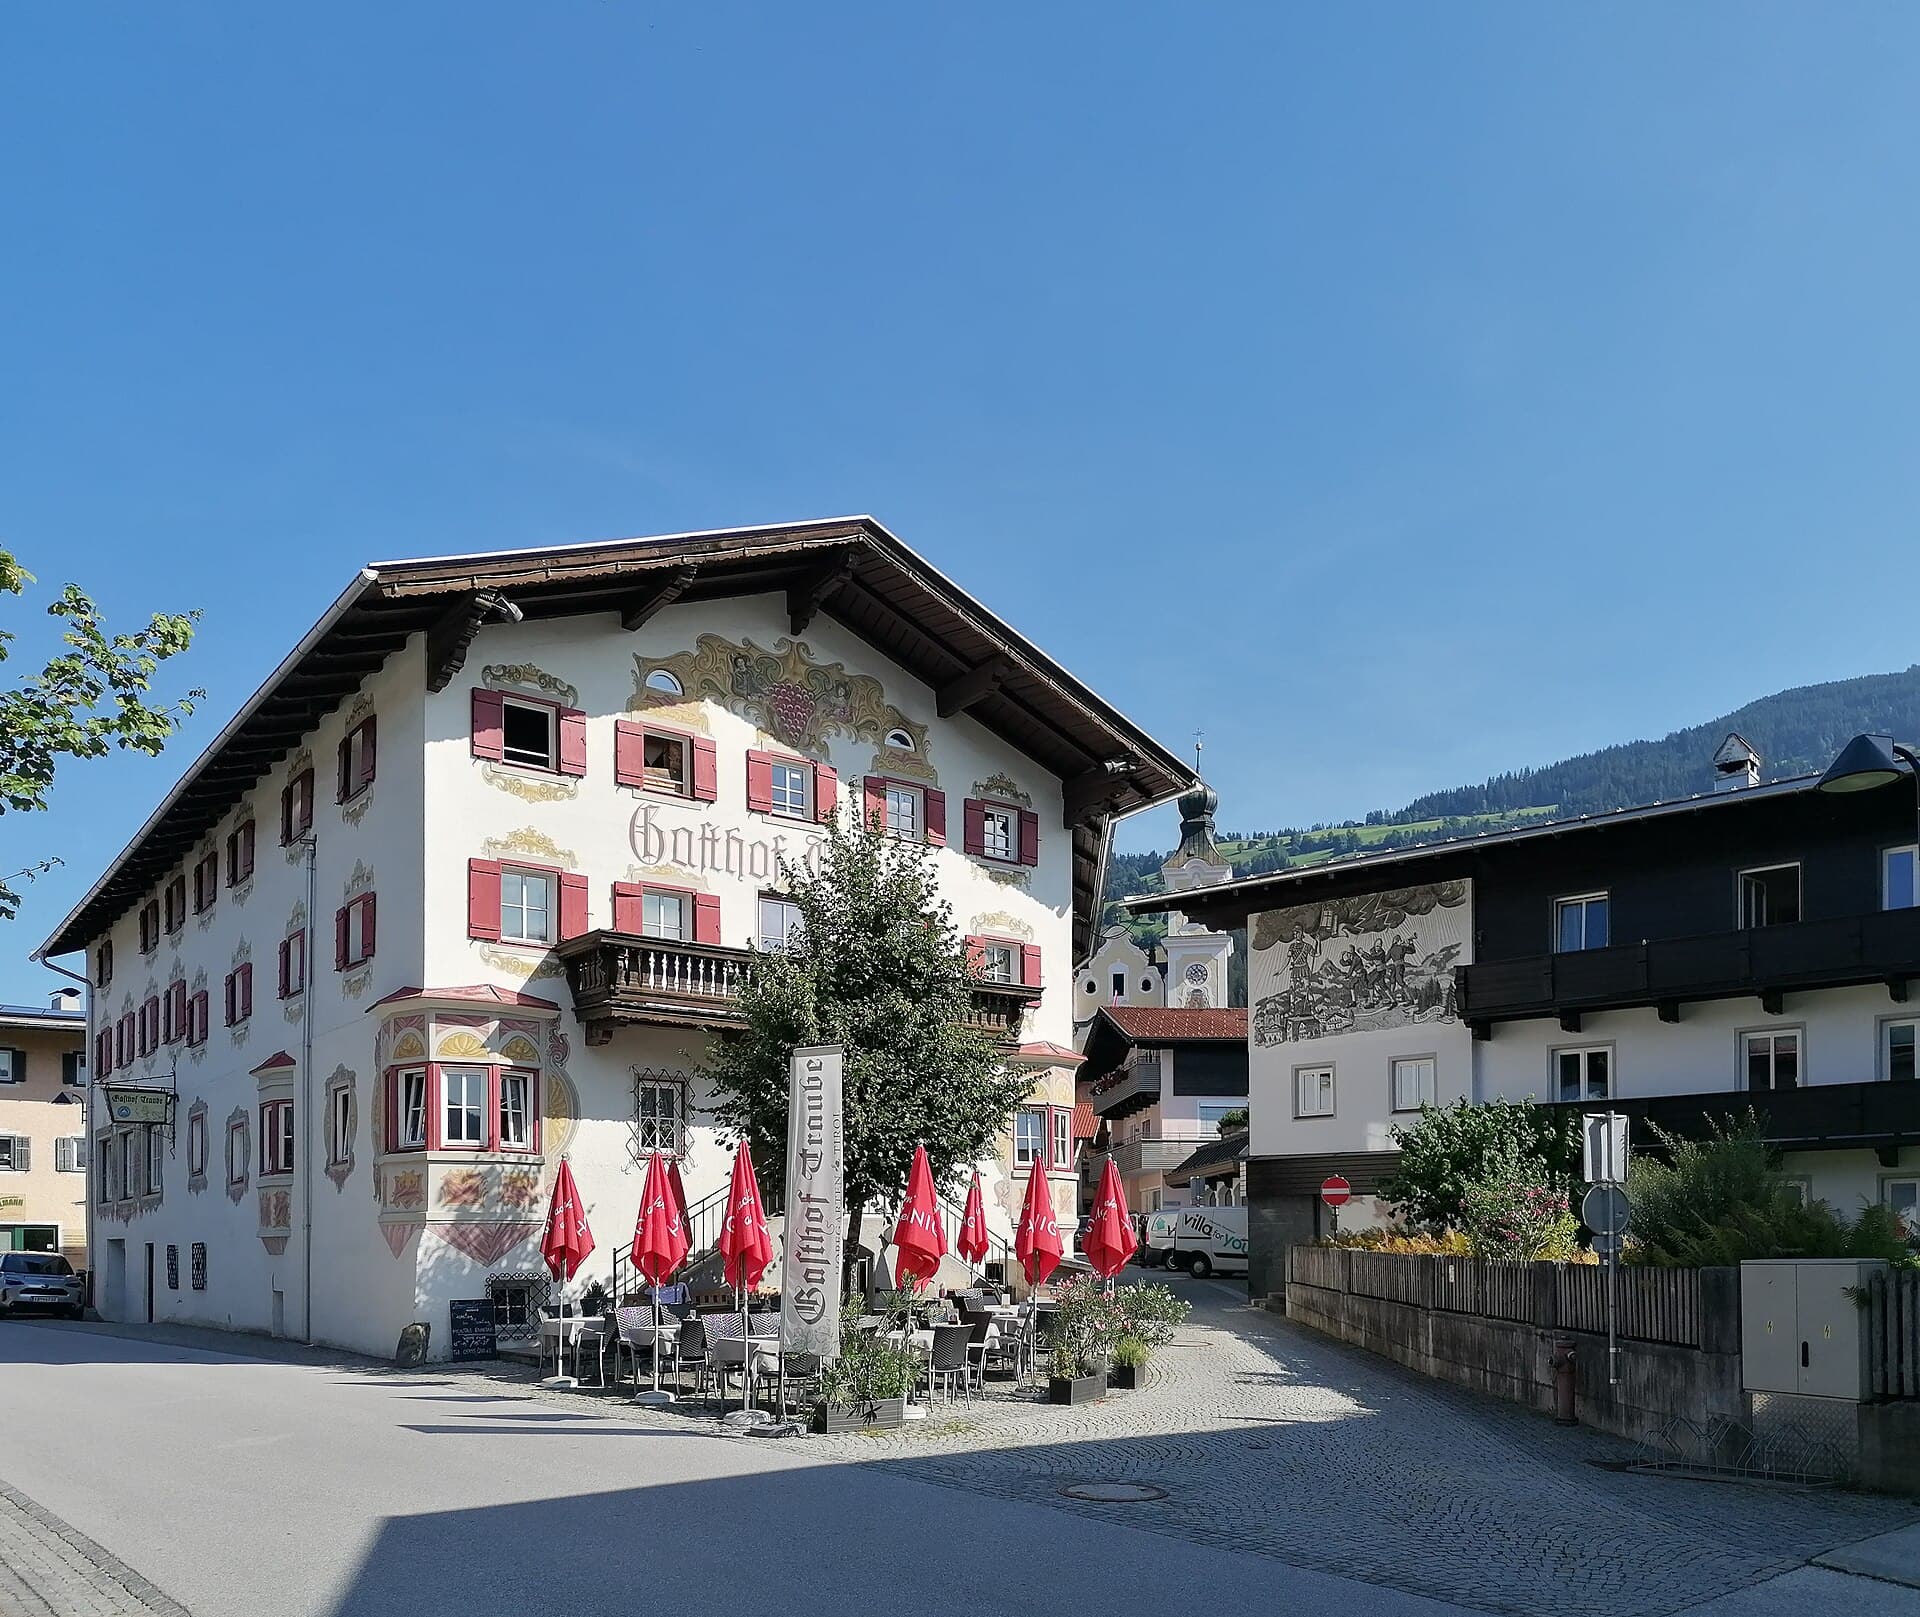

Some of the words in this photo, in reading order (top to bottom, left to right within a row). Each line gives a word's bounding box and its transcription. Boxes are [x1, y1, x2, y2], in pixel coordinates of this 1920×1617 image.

[799, 1058, 823, 1180] Traube
[1184, 1213, 1214, 1236] villa
[1213, 1229, 1224, 1240] for
